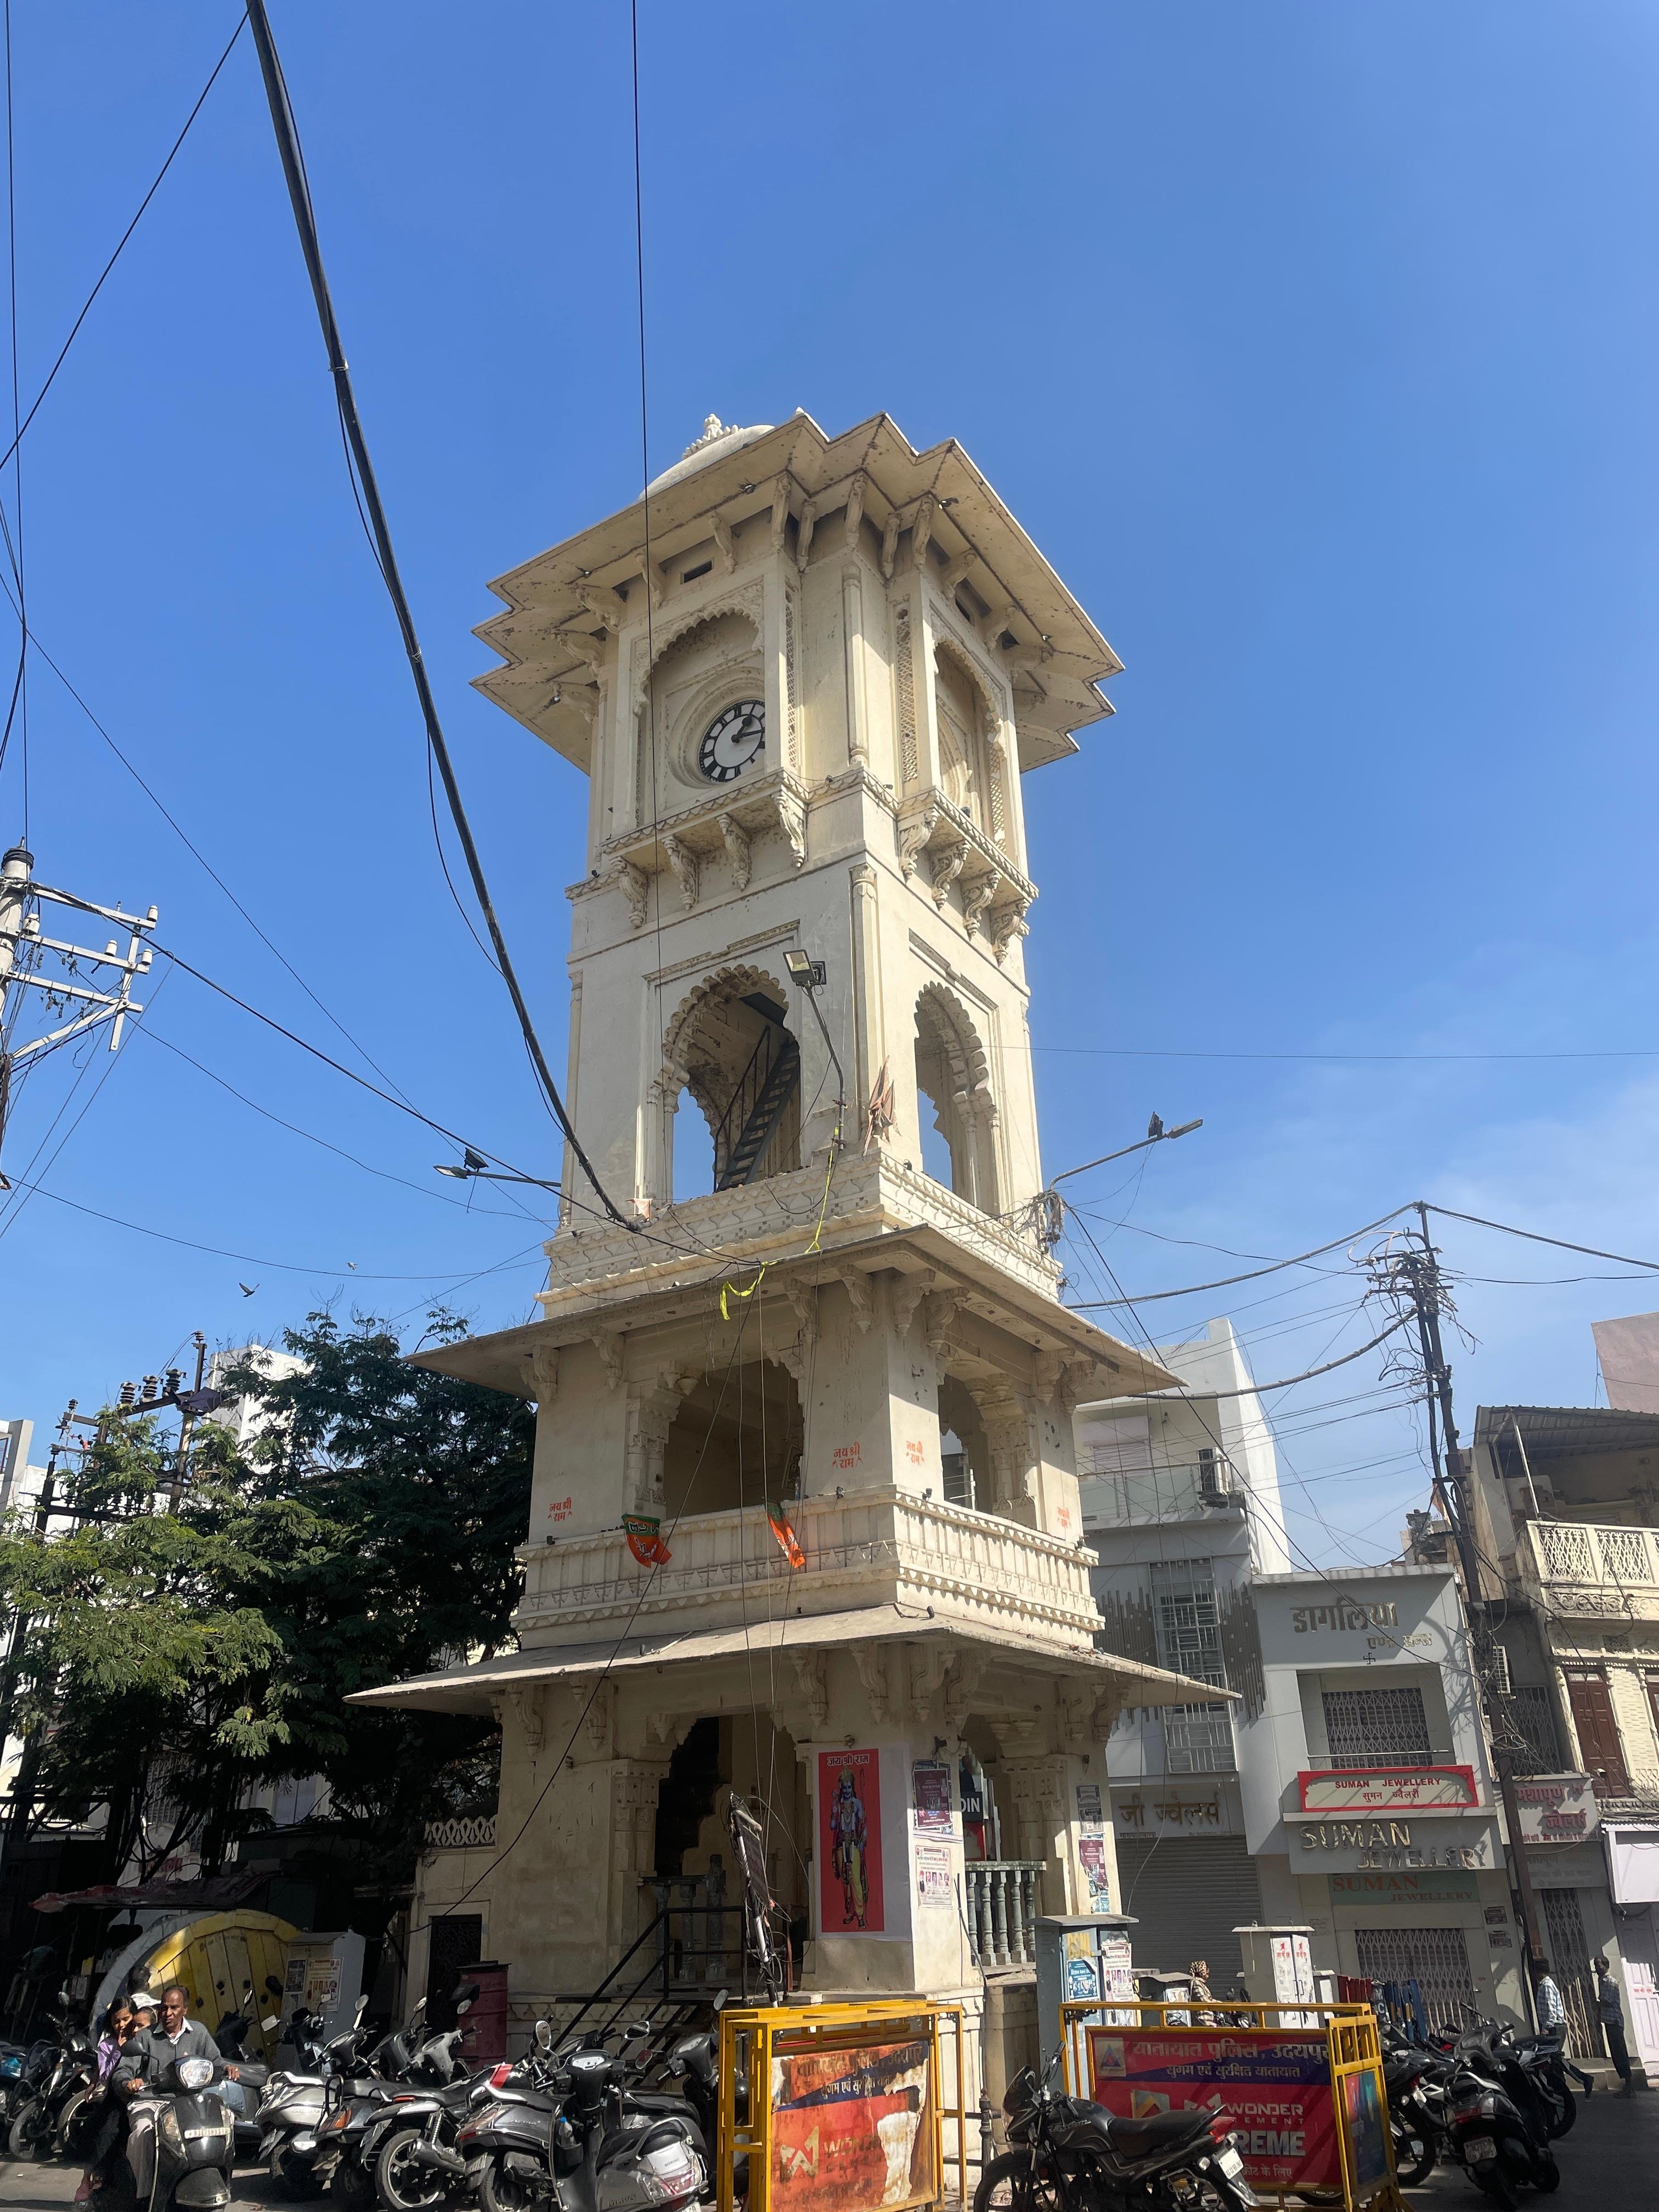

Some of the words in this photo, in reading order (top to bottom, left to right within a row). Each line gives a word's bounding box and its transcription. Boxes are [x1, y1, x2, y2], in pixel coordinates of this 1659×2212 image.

[833, 1448, 848, 1458] जय
[850, 1442, 860, 1456] श्री
[839, 1458, 854, 1469] राम
[549, 1502, 562, 1512] जय
[563, 1497, 572, 1510] श्री
[554, 1512, 566, 1522] राम
[1290, 1593, 1398, 1633] डागलिया
[827, 1756, 842, 1766] जय
[843, 1753, 853, 1765] श्री
[854, 1754, 870, 1765] राम
[1335, 1780, 1370, 1788] SUMAN
[1382, 1778, 1441, 1787] JEWELLERY
[1362, 1792, 1382, 1803] सुमन
[1299, 1822, 1410, 1849] SUMAN
[1357, 1839, 1487, 1869] JEWELLERY
[1333, 1874, 1419, 1892] SUMAN
[1391, 1892, 1473, 1902] JEWELLERY
[1132, 2042, 1203, 2058] यातायात
[1166, 2064, 1194, 2078] सुगम
[1198, 2062, 1212, 2075] एवं
[1216, 2063, 1252, 2079] सुरक्षित
[1255, 2066, 1300, 2077] यातायात
[841, 2078, 851, 2094] एवं
[1227, 2103, 1304, 2115] WONDER
[1233, 2130, 1306, 2156] REME
[1273, 2164, 1293, 2179] लिए
